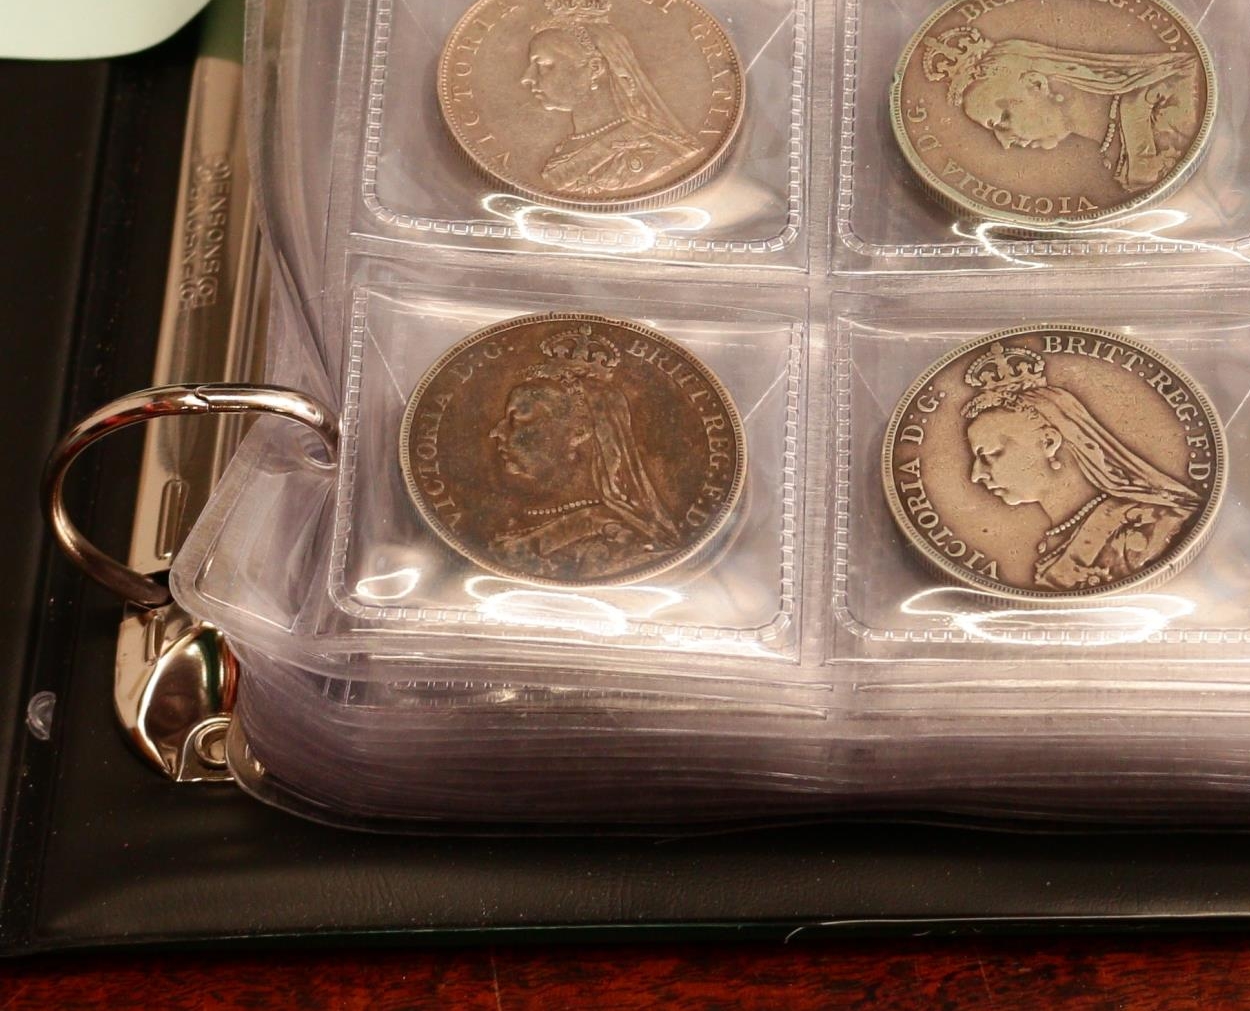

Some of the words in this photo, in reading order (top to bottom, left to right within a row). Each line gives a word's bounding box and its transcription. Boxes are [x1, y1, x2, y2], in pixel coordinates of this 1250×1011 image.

[451, 0, 523, 170] VICTORIA
[939, 156, 1100, 215] VICTORIA
[415, 391, 464, 534] VICTORIA
[899, 457, 1001, 582] VICTORIA
